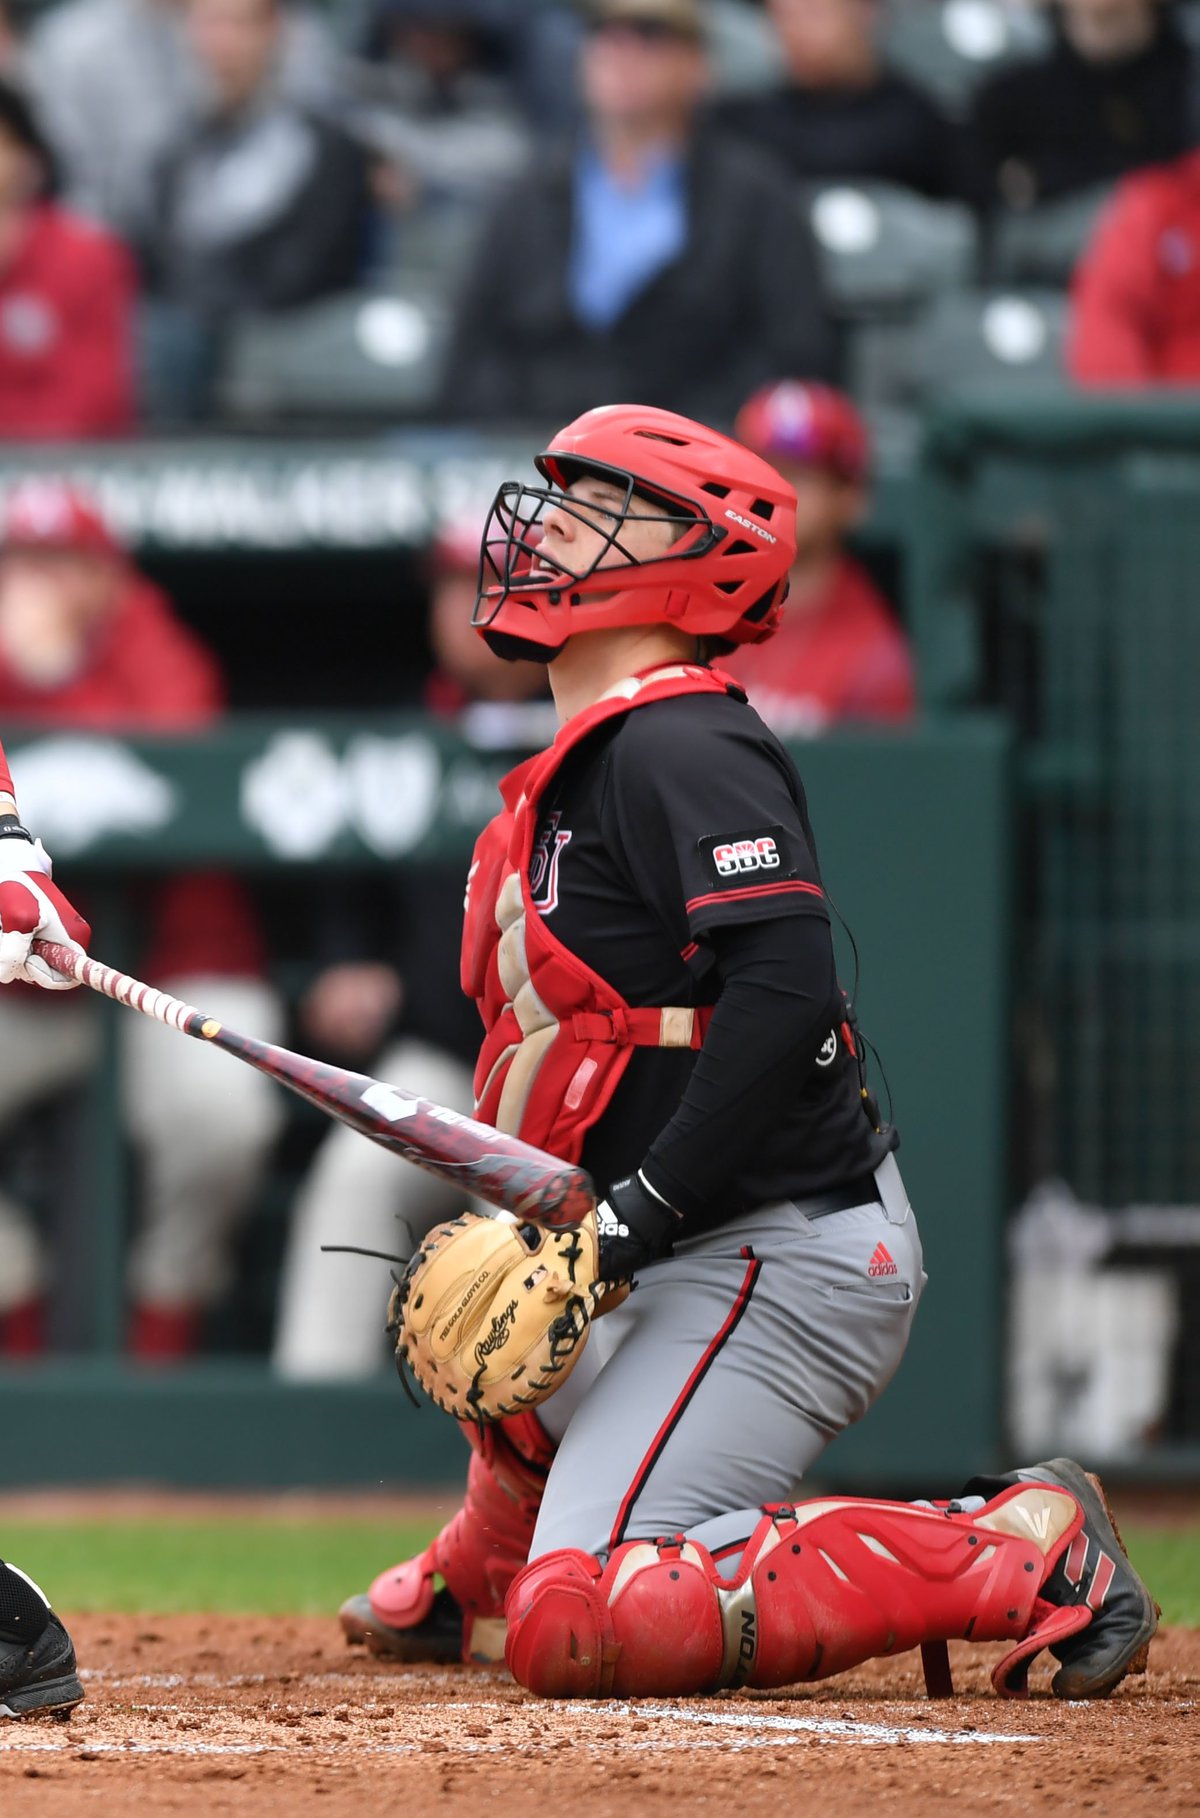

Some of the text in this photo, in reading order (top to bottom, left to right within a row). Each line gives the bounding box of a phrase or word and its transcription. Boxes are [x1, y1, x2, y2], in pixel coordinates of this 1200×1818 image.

[724, 509, 777, 544] EASTON
[712, 836, 780, 877] SBC
[867, 1262, 898, 1277] adidas
[439, 1322, 451, 1341] THE
[448, 1306, 464, 1328] GOLD
[461, 1282, 481, 1308] GLOVE
[474, 1298, 519, 1366] Rawlings
